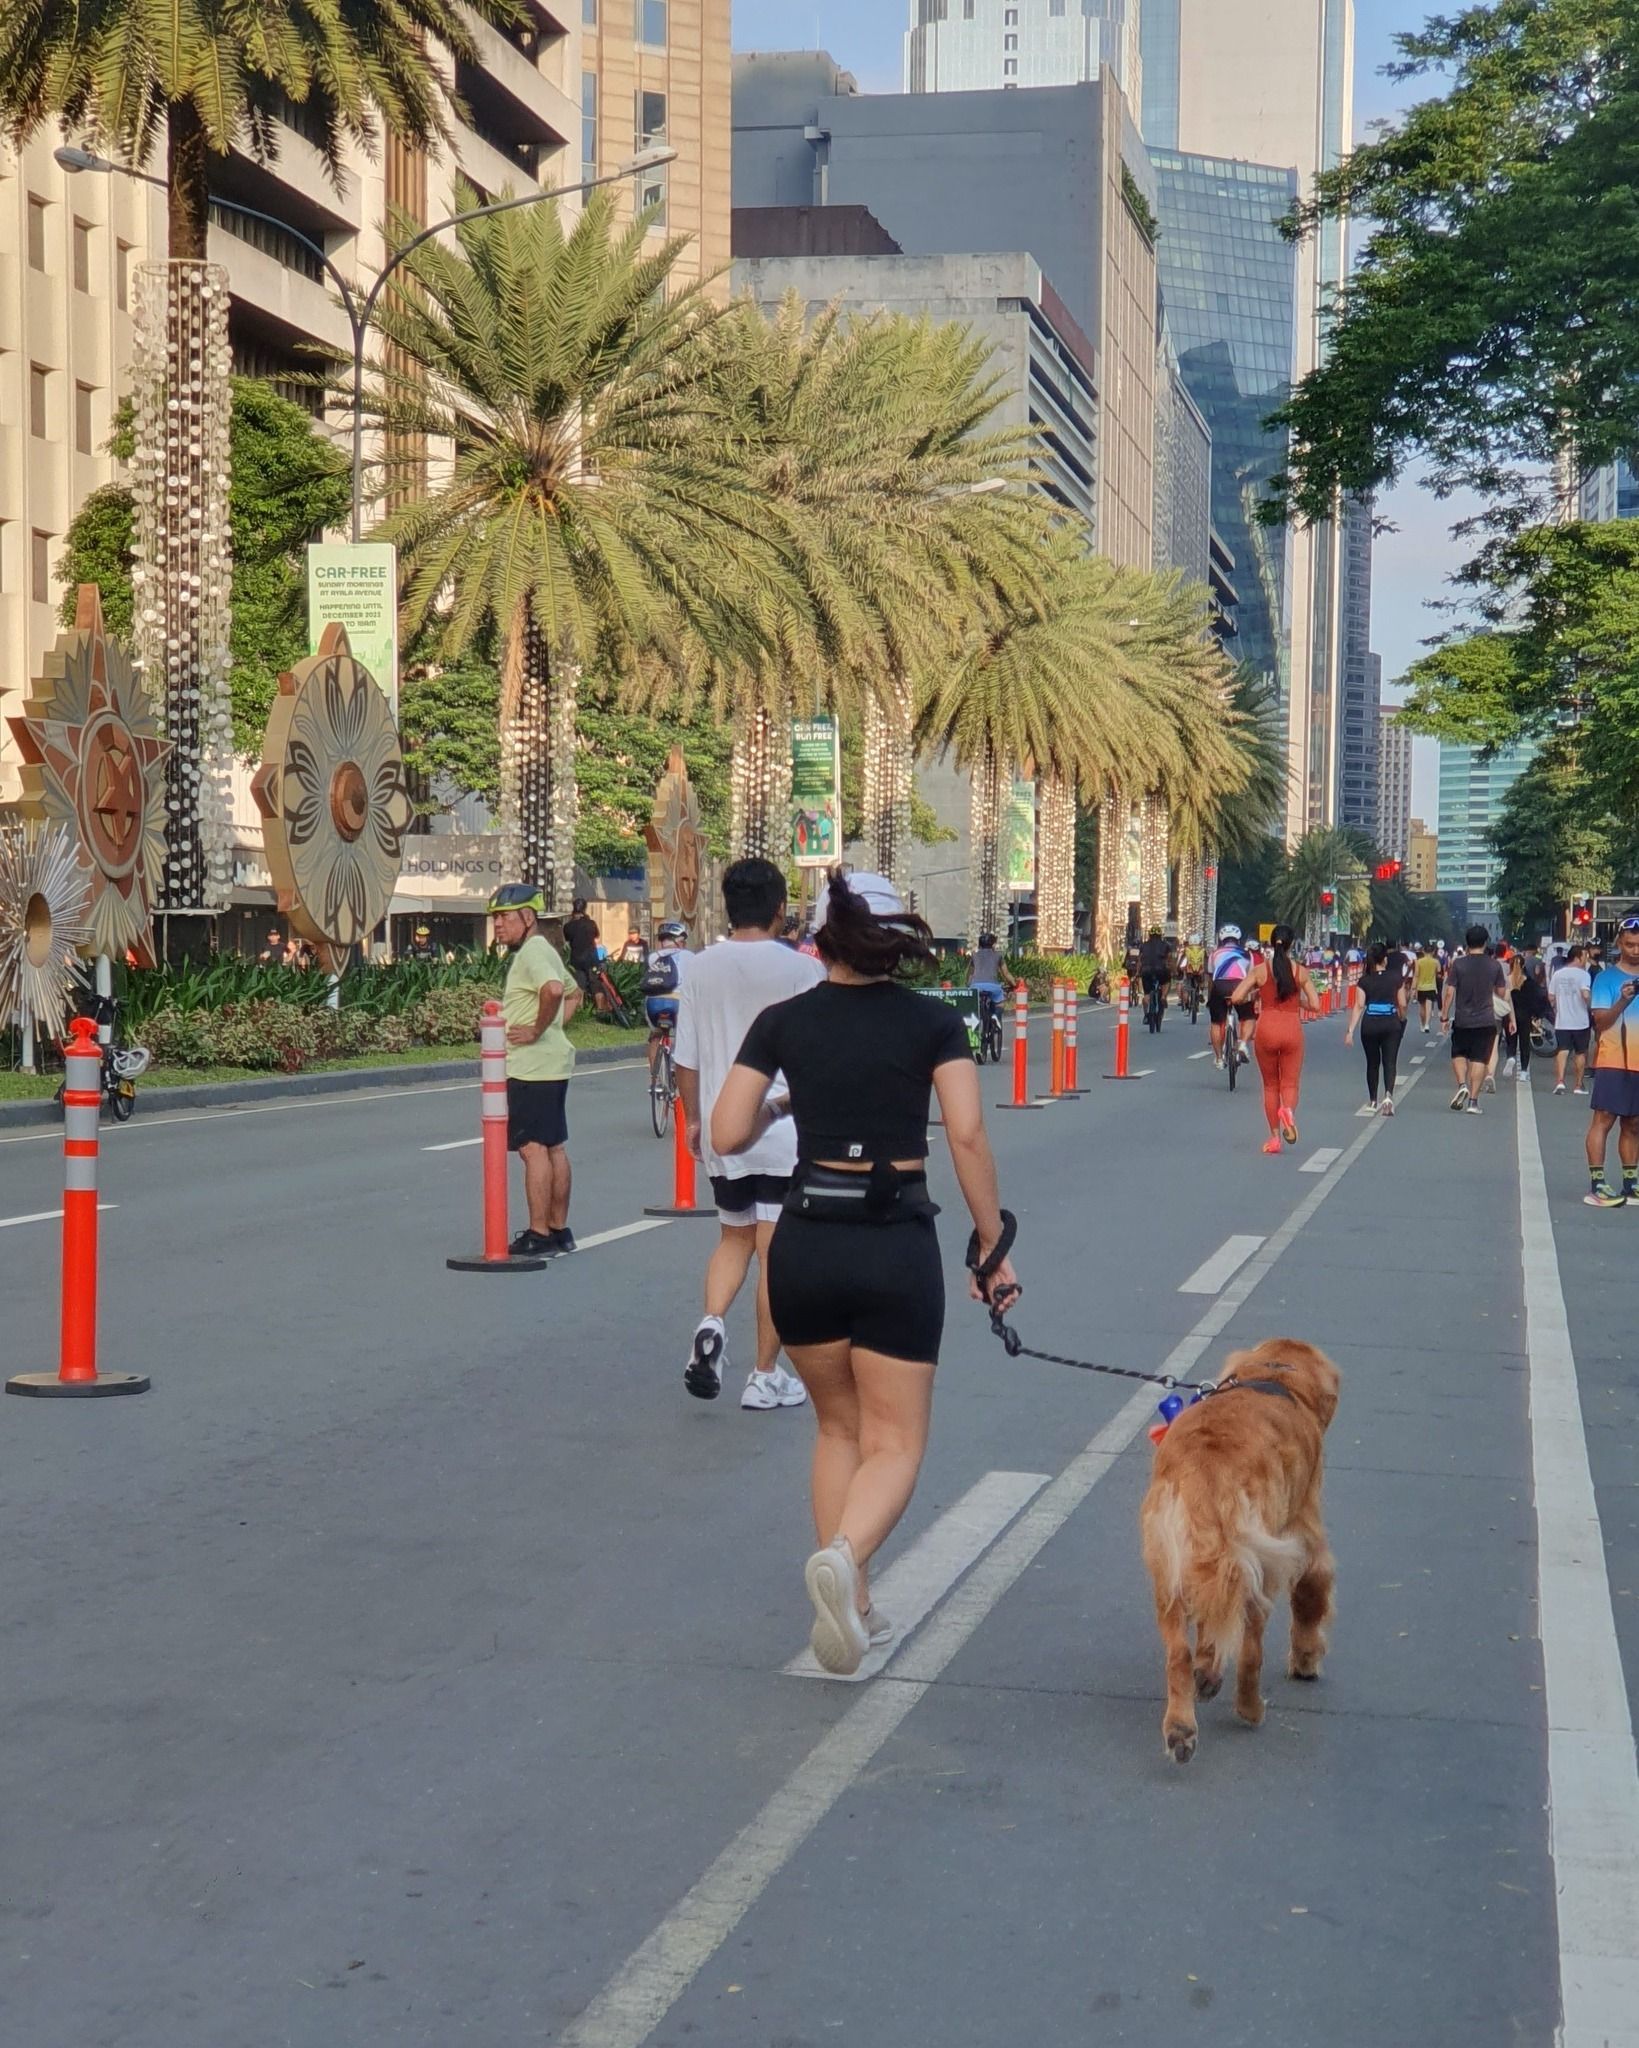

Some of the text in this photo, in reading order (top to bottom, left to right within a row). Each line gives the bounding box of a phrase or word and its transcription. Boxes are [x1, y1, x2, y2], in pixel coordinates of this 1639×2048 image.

[315, 567, 387, 578] CAR-FREE
[813, 732, 832, 740] FREE
[408, 860, 484, 873] HOLDINGS
